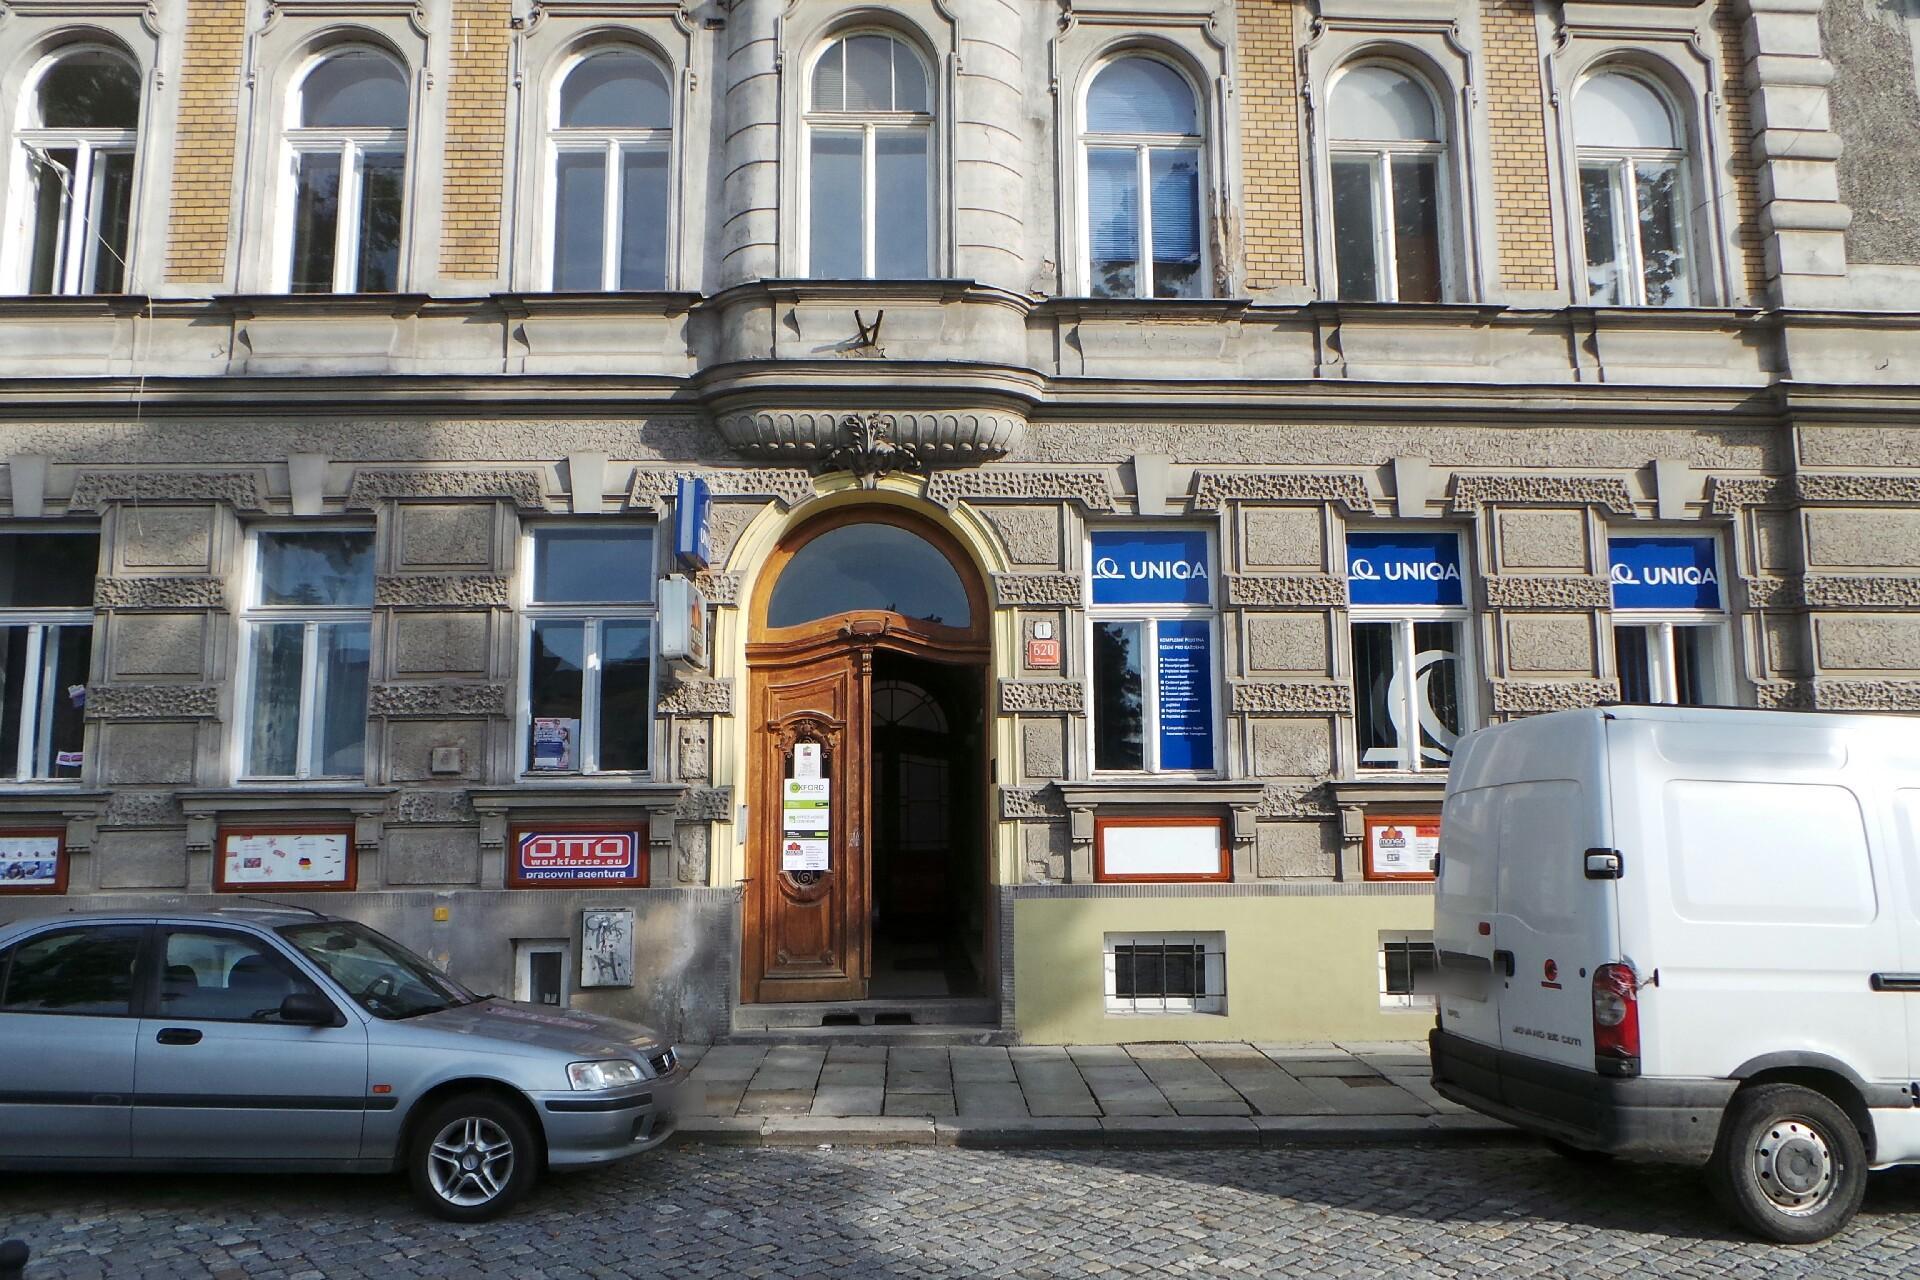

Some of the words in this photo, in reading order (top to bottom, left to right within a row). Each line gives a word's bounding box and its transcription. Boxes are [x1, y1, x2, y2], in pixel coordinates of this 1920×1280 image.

[1130, 561, 1207, 579] UNIQA
[1384, 562, 1459, 580] UNIQA
[1643, 567, 1717, 585] UNIQA
[1033, 643, 1054, 656] 620
[790, 783, 825, 792] OXFORD
[529, 839, 623, 857] OTTO
[530, 857, 622, 866] workforce.eu
[526, 869, 574, 879] pracovní
[577, 870, 626, 879] agentura
